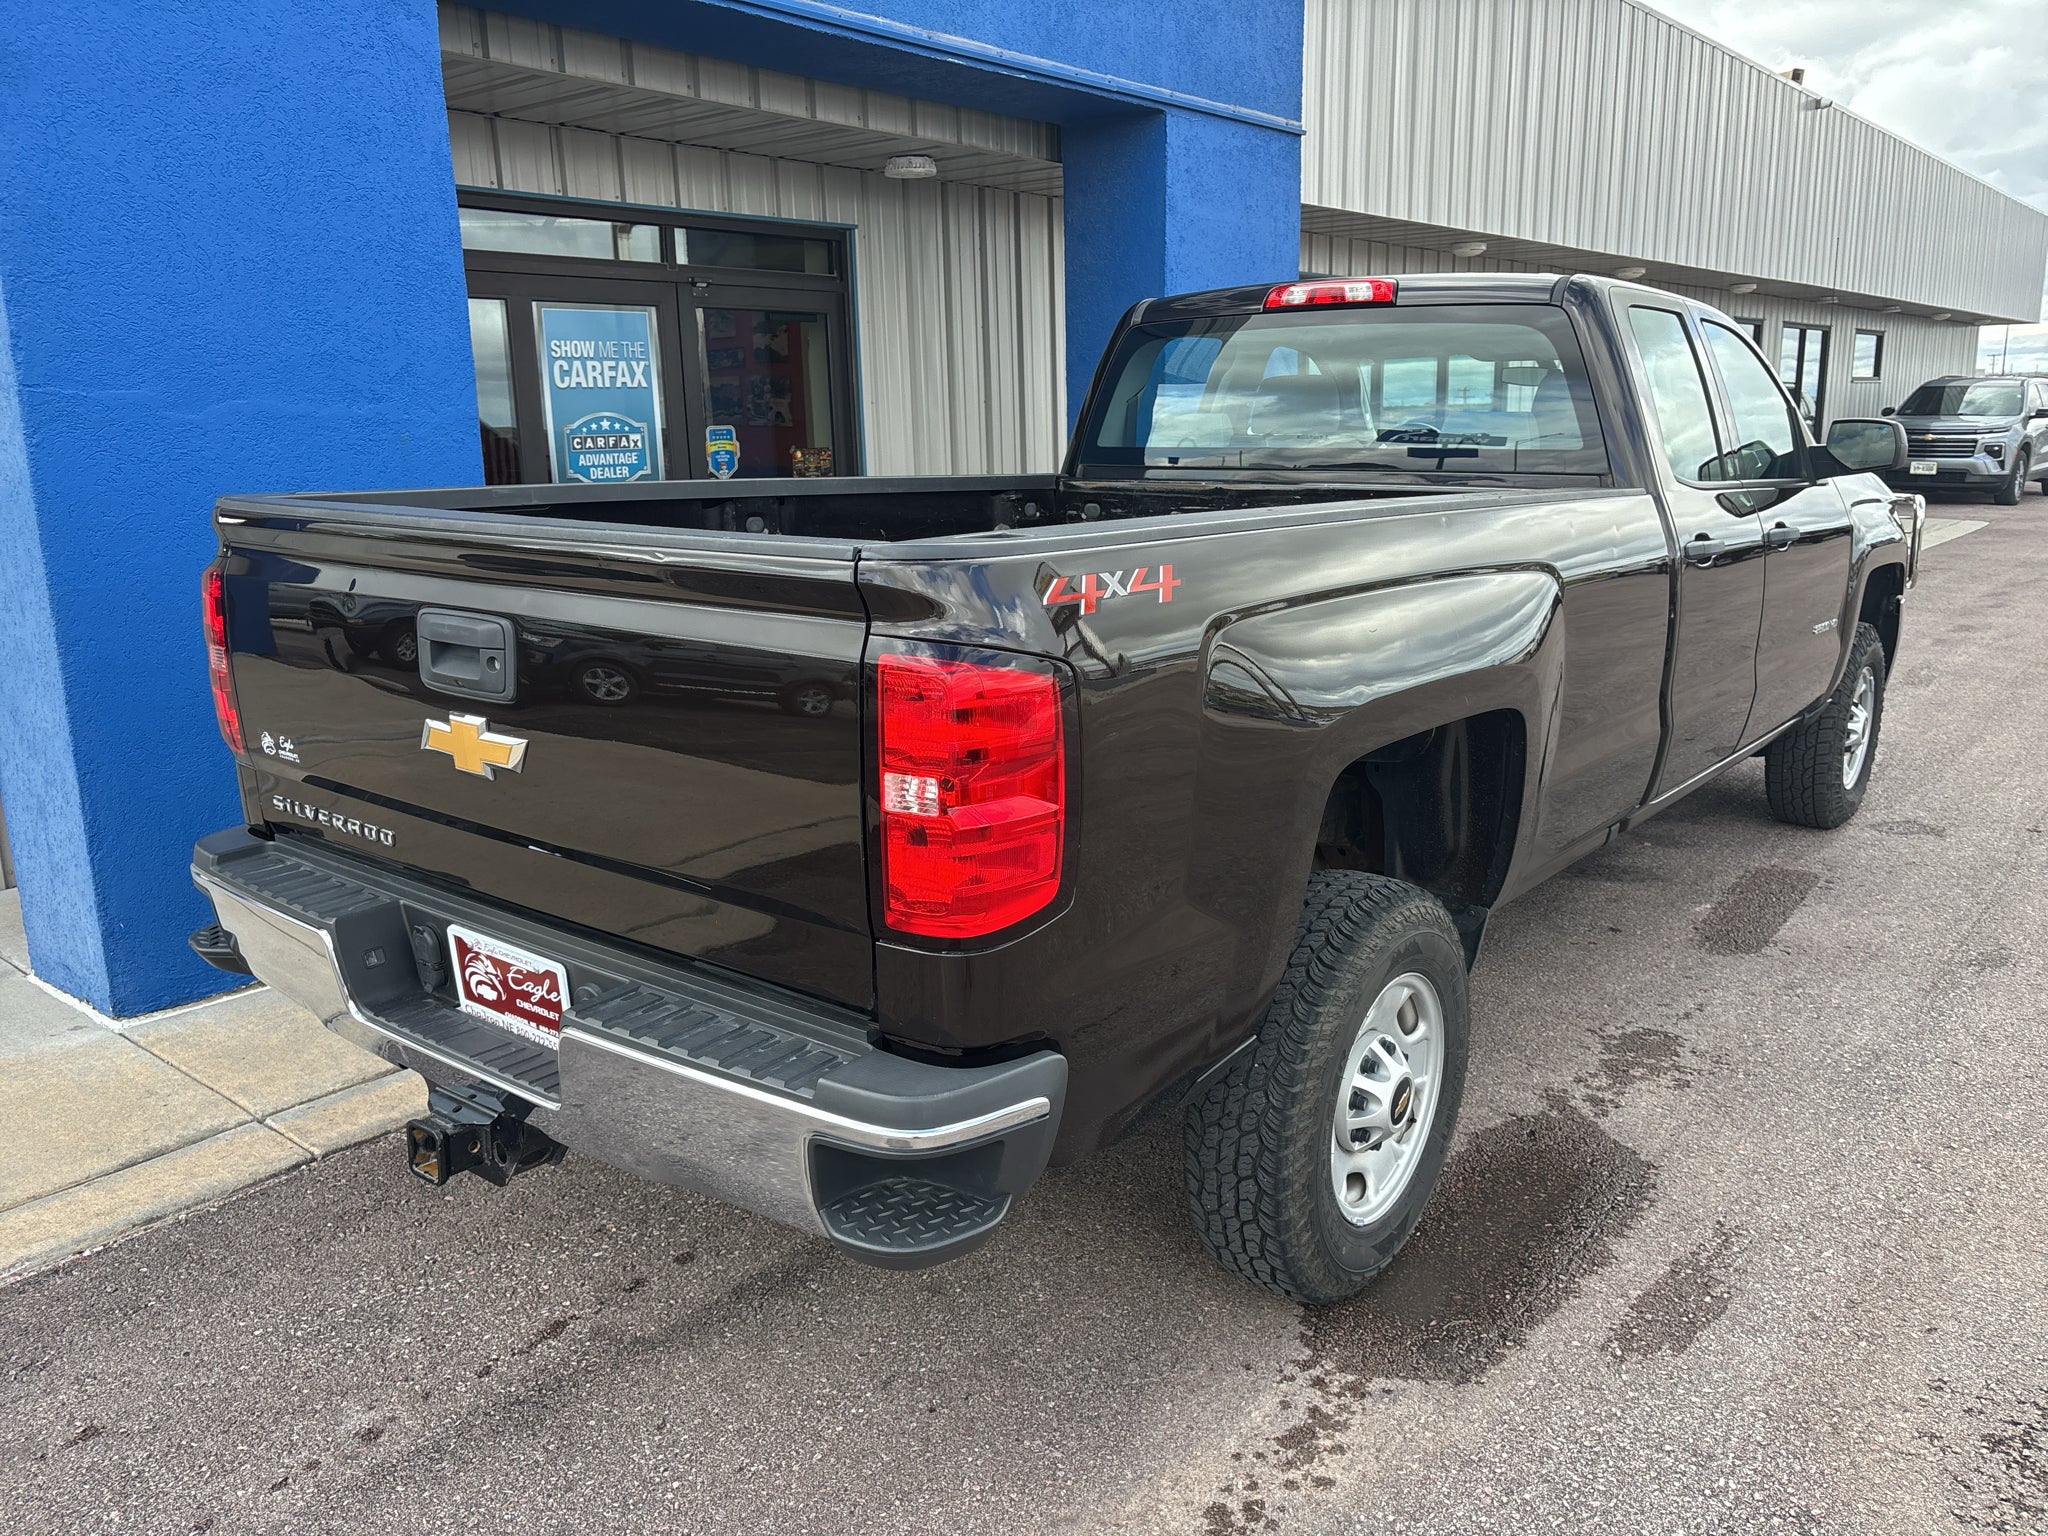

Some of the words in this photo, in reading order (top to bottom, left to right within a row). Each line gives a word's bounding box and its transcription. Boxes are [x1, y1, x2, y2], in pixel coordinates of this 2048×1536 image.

[551, 340, 595, 358] SHOW
[599, 341, 618, 358] ME
[621, 341, 646, 359] THE
[553, 360, 649, 388] CARFAX
[571, 434, 642, 450] CARFAX
[578, 453, 638, 467] ADVANTAGE
[590, 466, 630, 480] DEALER
[272, 794, 397, 847] SILVERADO
[506, 966, 561, 1002] Eagle
[516, 998, 560, 1021] CHEVROLET
